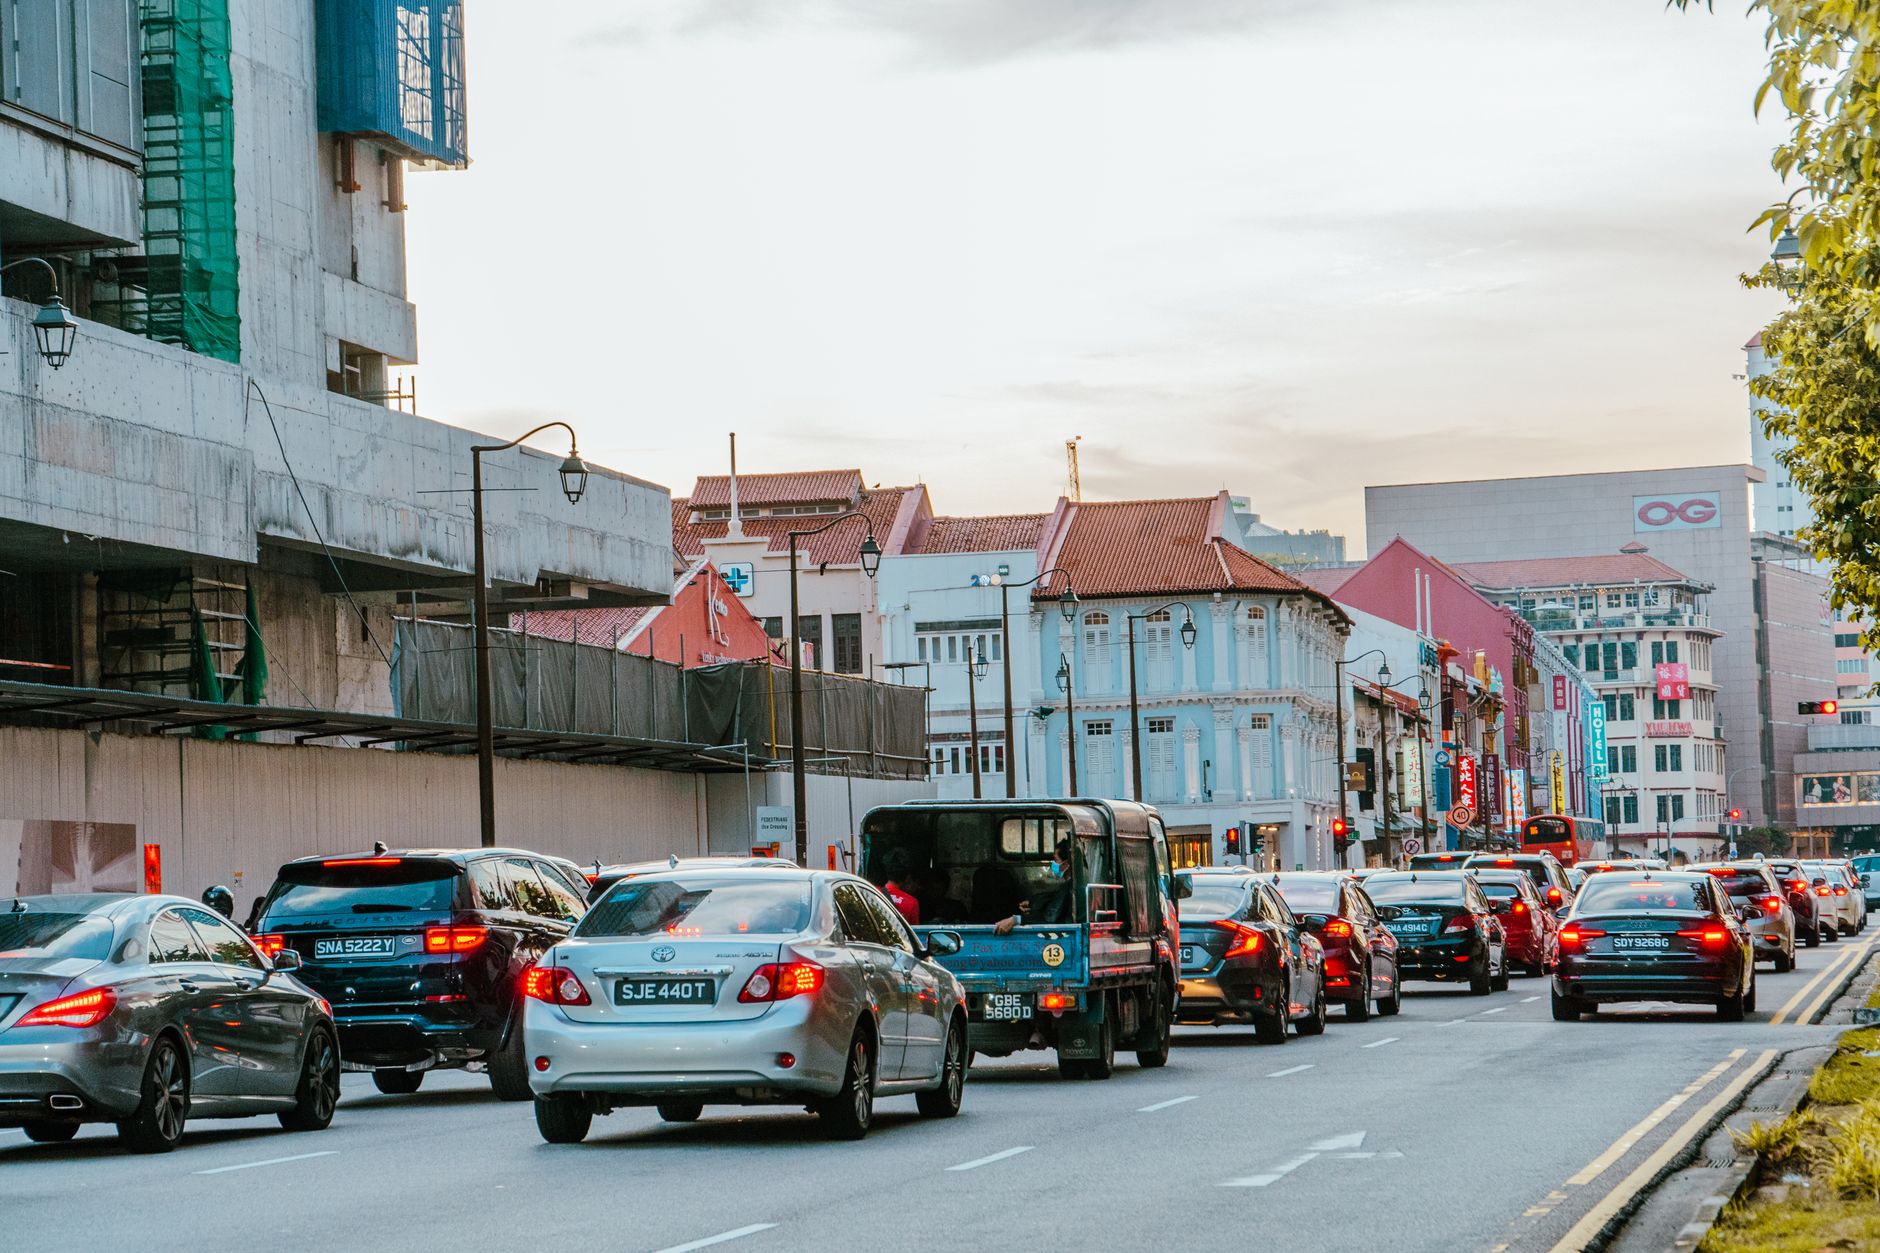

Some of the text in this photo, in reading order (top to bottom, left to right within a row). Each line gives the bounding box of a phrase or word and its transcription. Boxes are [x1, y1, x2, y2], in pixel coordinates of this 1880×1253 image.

[1638, 499, 1717, 526] OG
[1593, 707, 1604, 761] HOTEL
[1456, 810, 1467, 821] 40
[1045, 946, 1061, 958] 13
[995, 994, 1021, 1007] GBE
